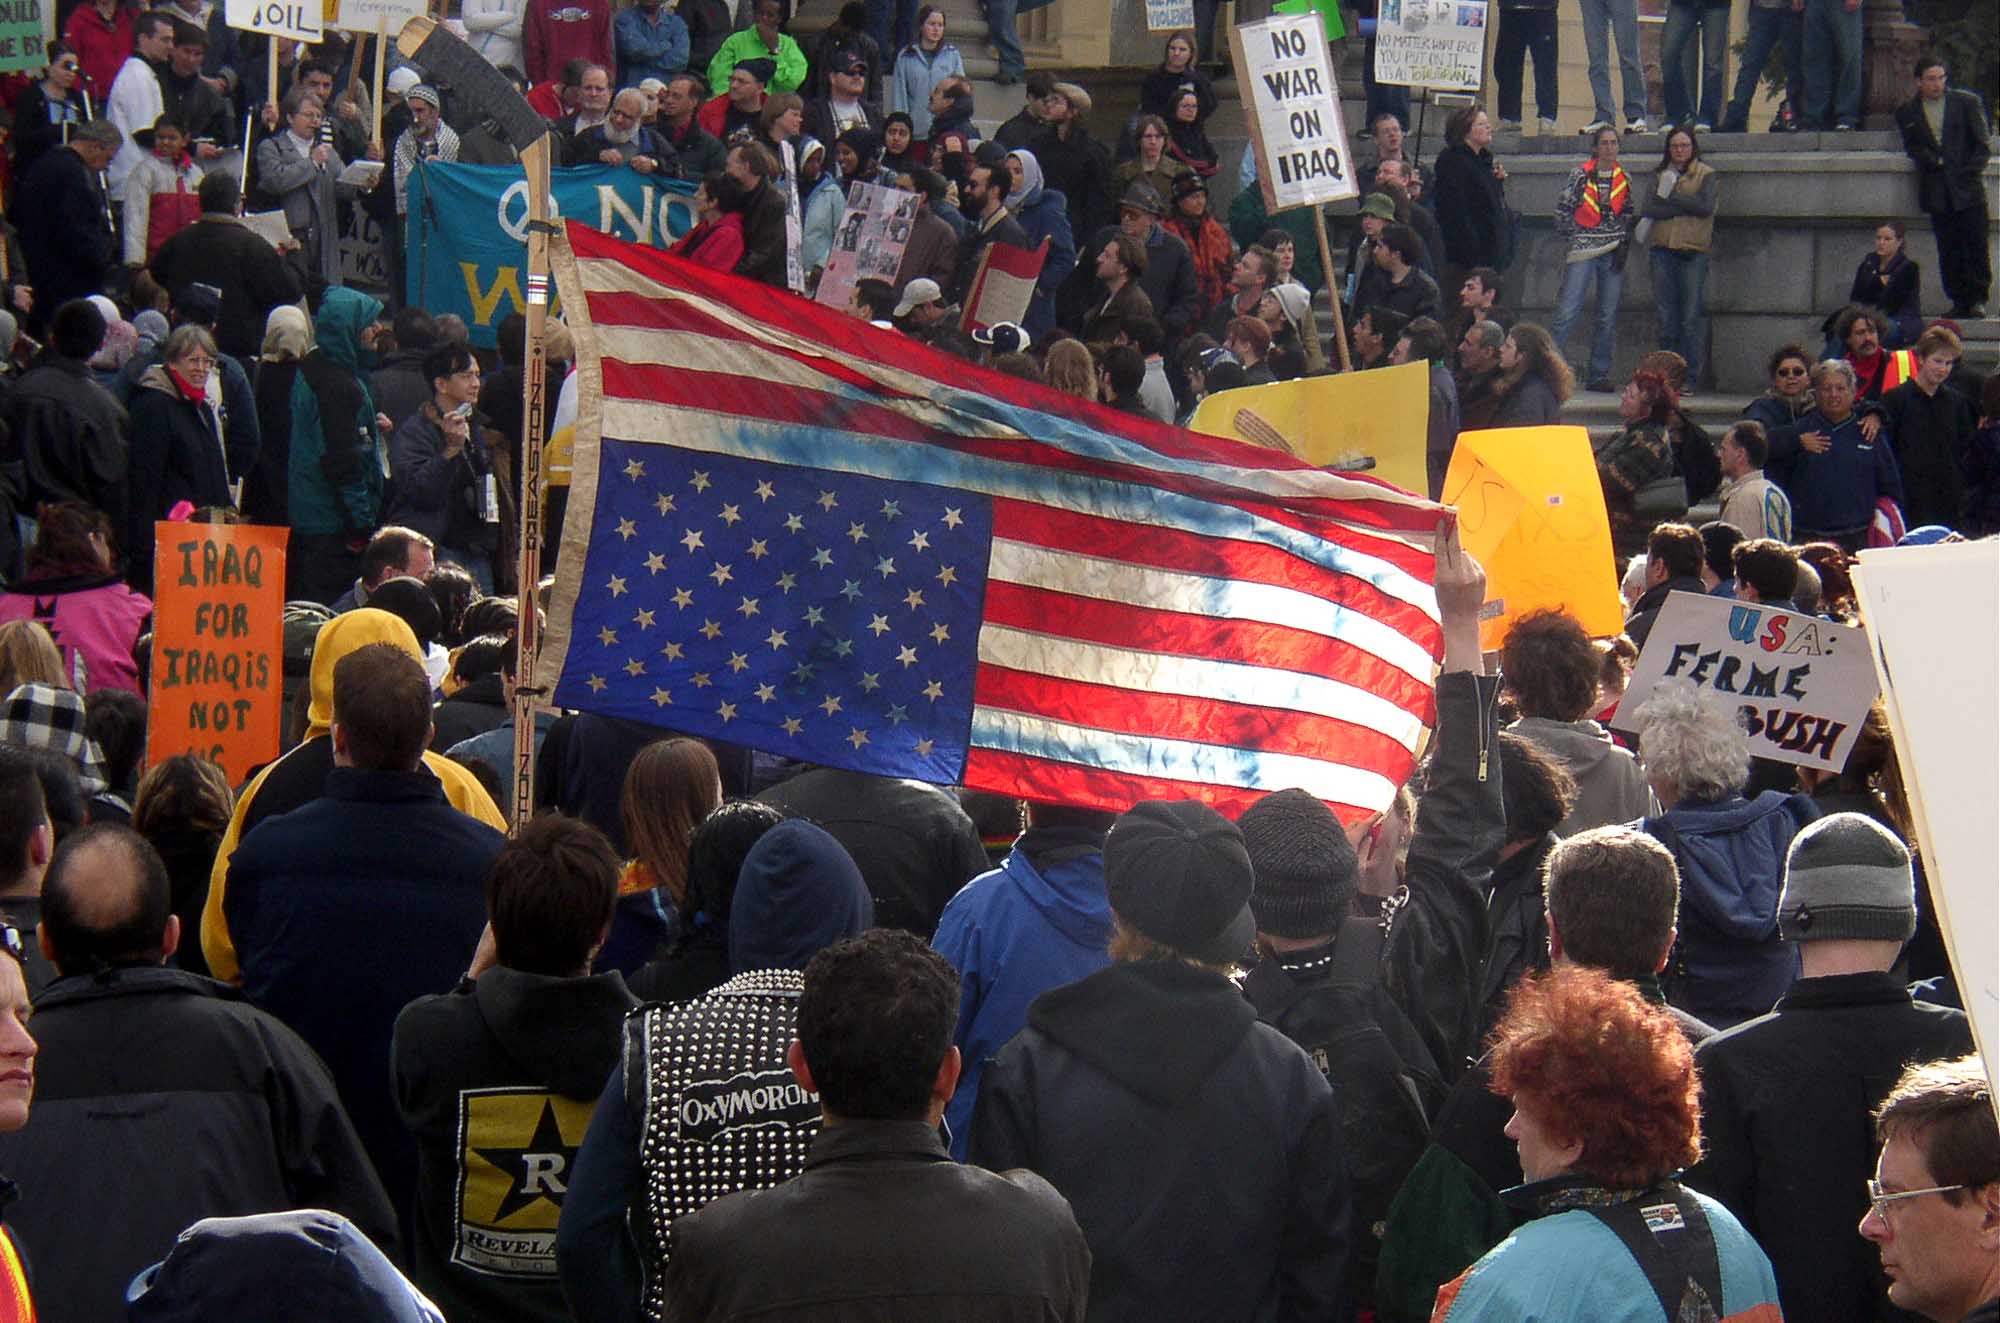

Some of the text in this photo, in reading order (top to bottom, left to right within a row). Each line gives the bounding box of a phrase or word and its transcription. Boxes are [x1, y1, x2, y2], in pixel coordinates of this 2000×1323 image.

[266, 3, 319, 34] OIL
[1271, 29, 1306, 59] NO
[1263, 67, 1323, 101] WAR
[1290, 109, 1322, 140] ON
[1277, 147, 1343, 184] IRAQ
[527, 383, 541, 520] EASTON
[177, 540, 263, 588] IRAQ
[194, 601, 249, 638] FOR
[1728, 605, 1837, 656] USA:
[1664, 642, 1810, 702] FERME
[189, 698, 252, 731] NOT
[520, 1152, 568, 1193] R
